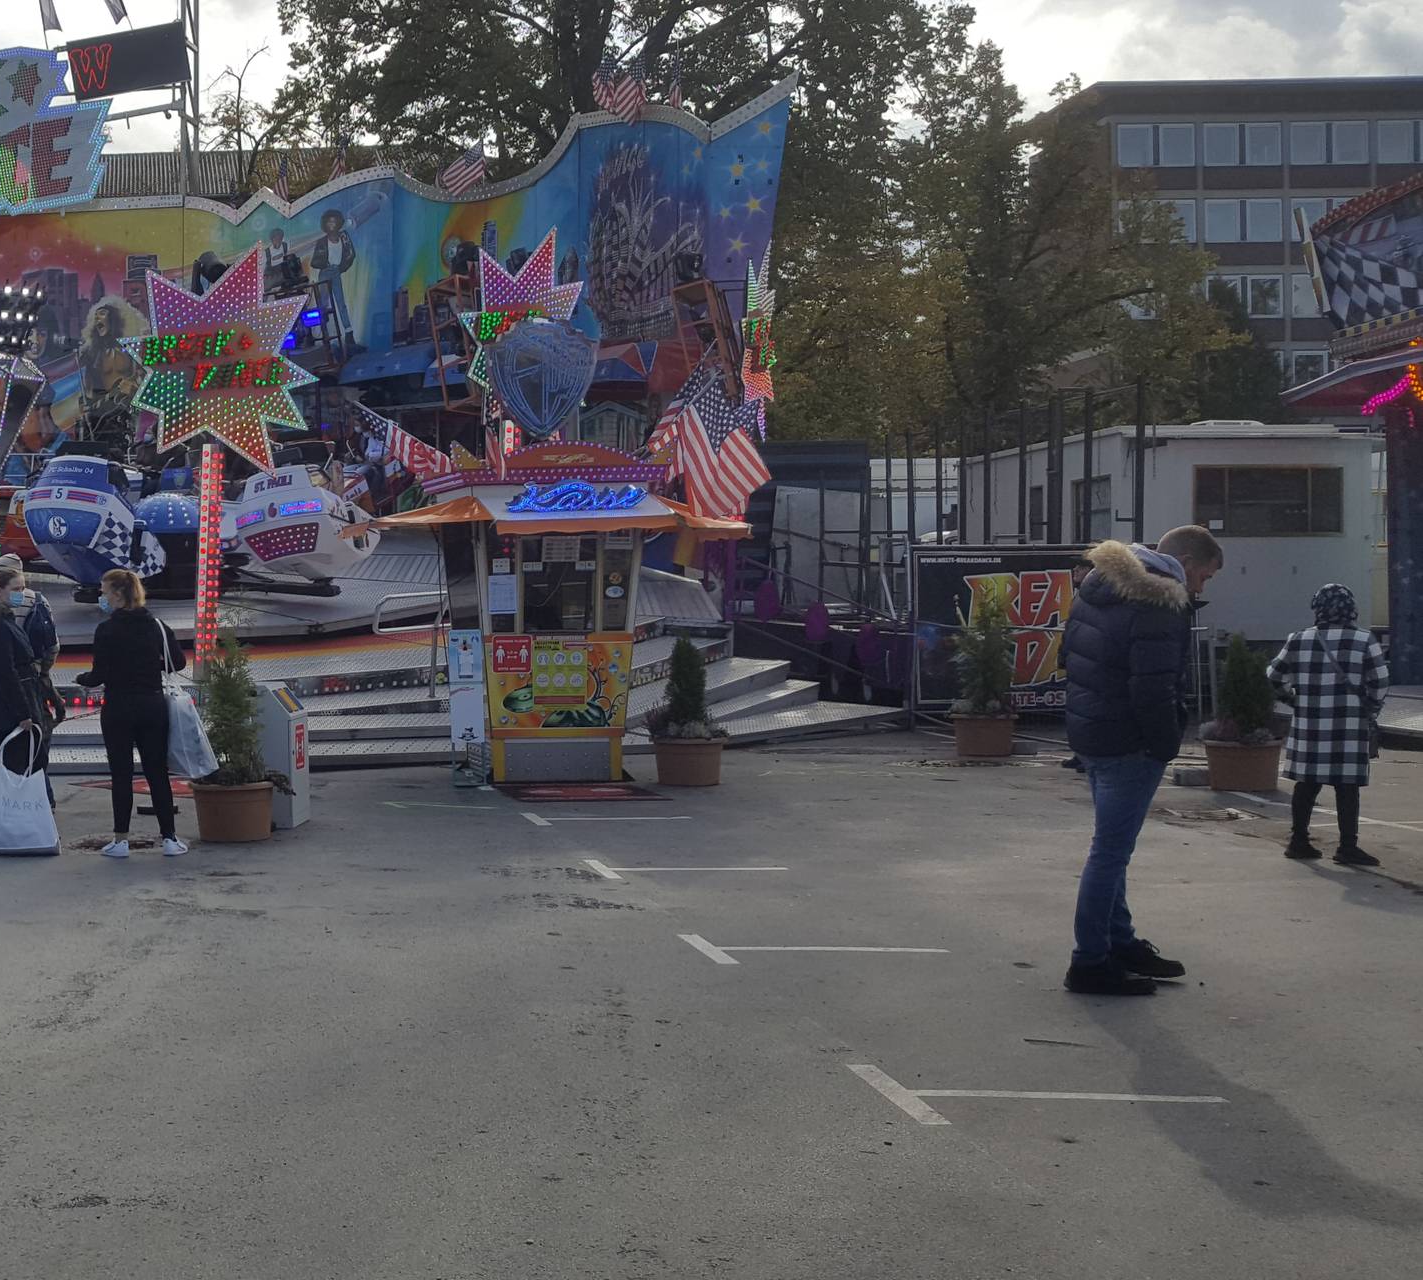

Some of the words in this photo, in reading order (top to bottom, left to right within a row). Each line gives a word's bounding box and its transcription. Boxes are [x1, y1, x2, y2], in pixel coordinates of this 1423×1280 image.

[68, 42, 113, 95] W
[55, 487, 64, 500] 5
[267, 502, 278, 518] 6
